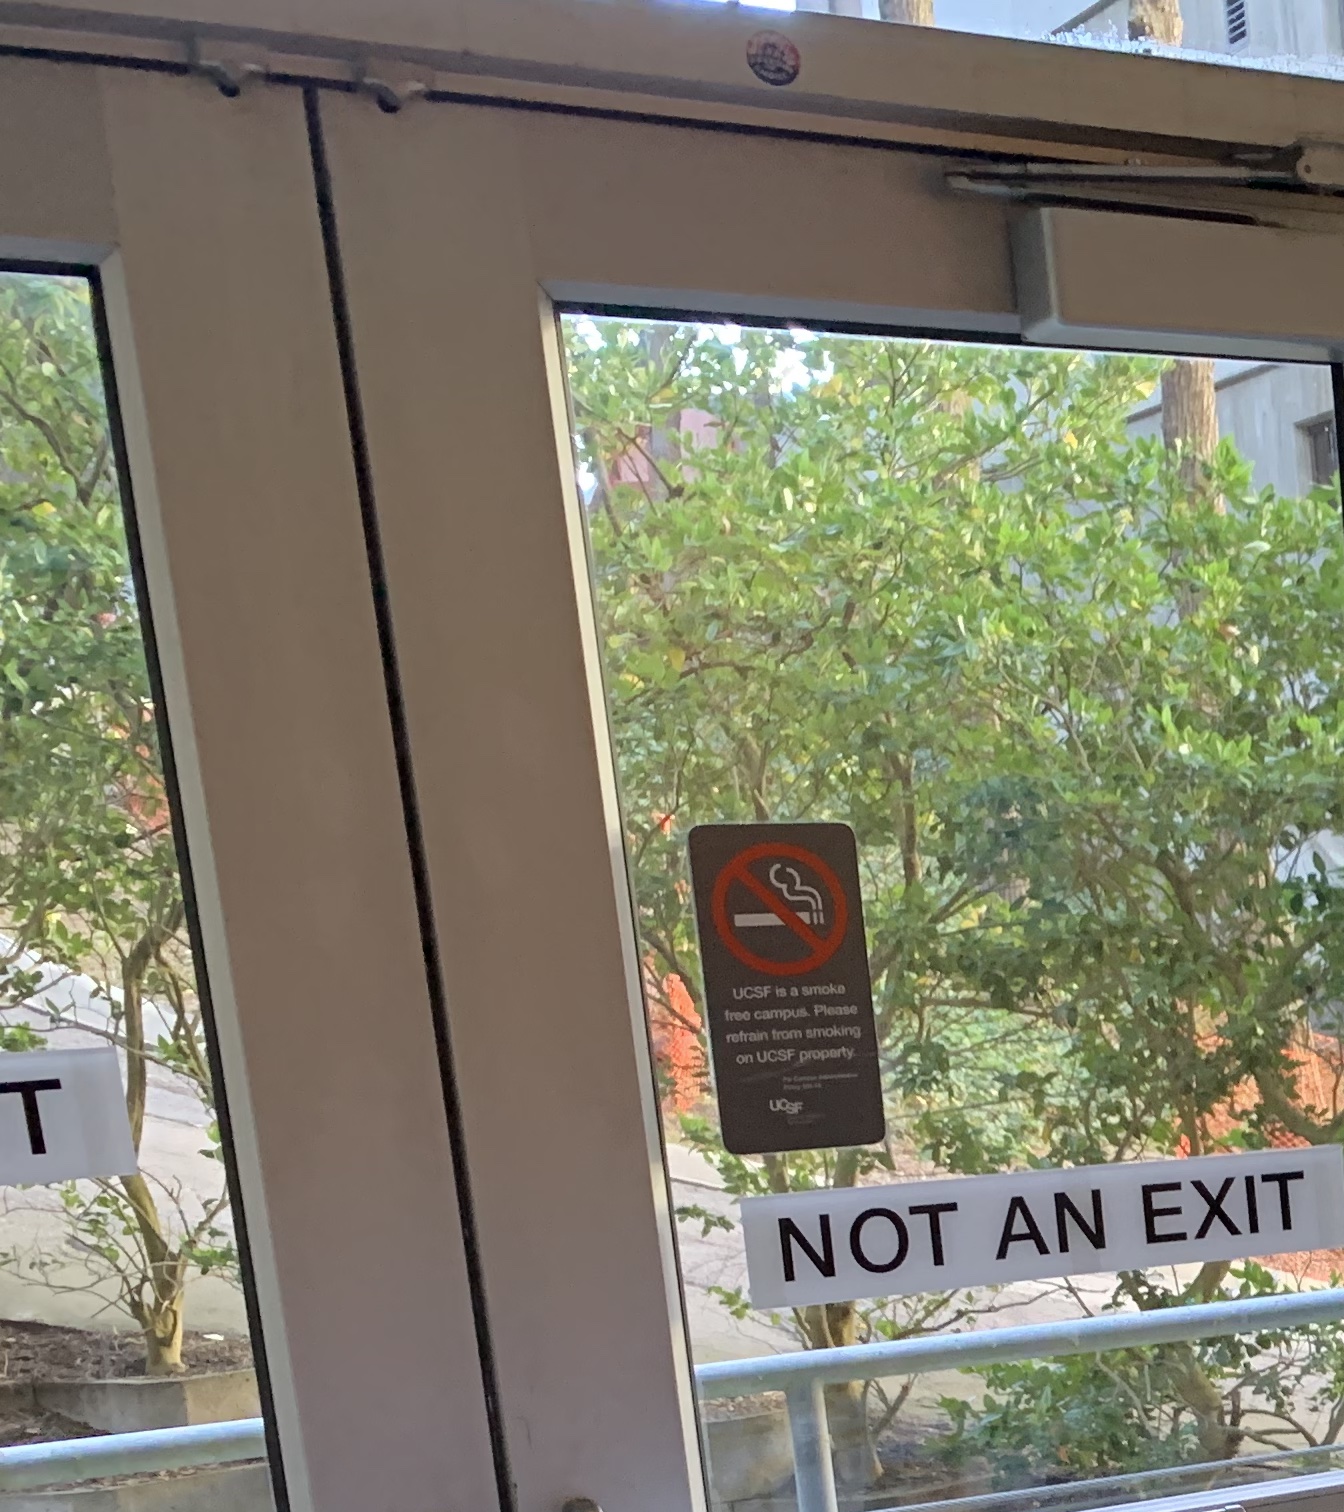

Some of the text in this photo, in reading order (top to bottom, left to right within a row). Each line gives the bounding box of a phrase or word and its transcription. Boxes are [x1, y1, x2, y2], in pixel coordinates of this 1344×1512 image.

[733, 983, 846, 1000] UCSF is a smoke
[724, 1004, 859, 1022] free campus. Please
[725, 1024, 862, 1043] refrain from smoking
[735, 1053, 754, 1065] on
[756, 1048, 796, 1064] UCSF
[769, 1098, 804, 1115] UCSF
[778, 1170, 1305, 1282] NOT AN EXIT
